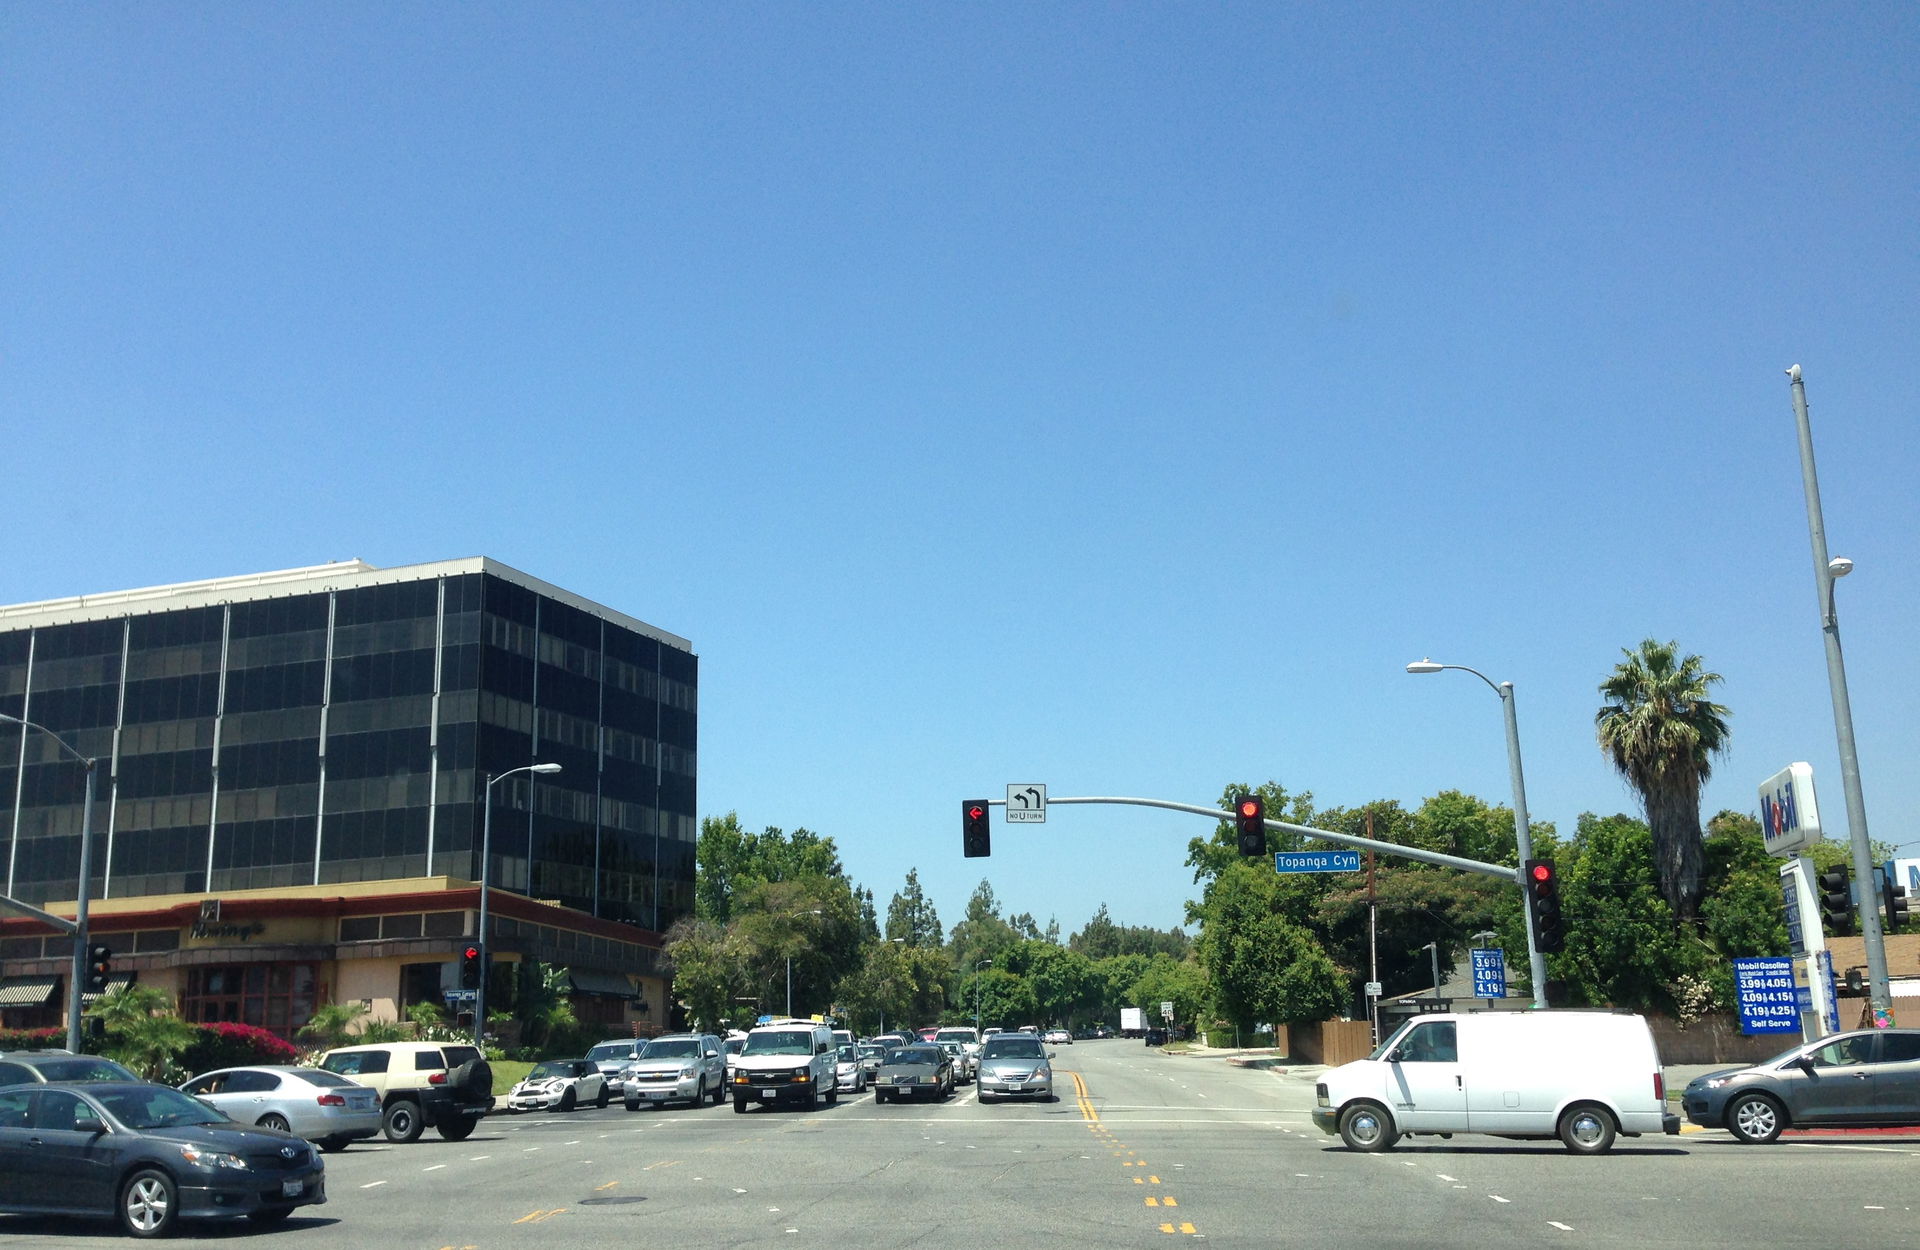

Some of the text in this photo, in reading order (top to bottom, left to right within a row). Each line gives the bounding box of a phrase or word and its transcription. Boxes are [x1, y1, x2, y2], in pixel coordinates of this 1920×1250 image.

[1020, 812, 1026, 820] U
[1761, 782, 1798, 841] Mobil
[1279, 855, 1356, 869] Topanga Cyn
[1476, 958, 1496, 967] 3.99
[1477, 970, 1498, 980] 4.09
[1478, 983, 1499, 993] 4.19
[1740, 979, 1761, 989] 3.99
[1766, 978, 1787, 988] 4.05
[1742, 993, 1762, 1002] 4.09
[1768, 992, 1789, 1002] 4.15
[1744, 1006, 1764, 1016] 4.19
[1770, 1005, 1791, 1016] 4.25
